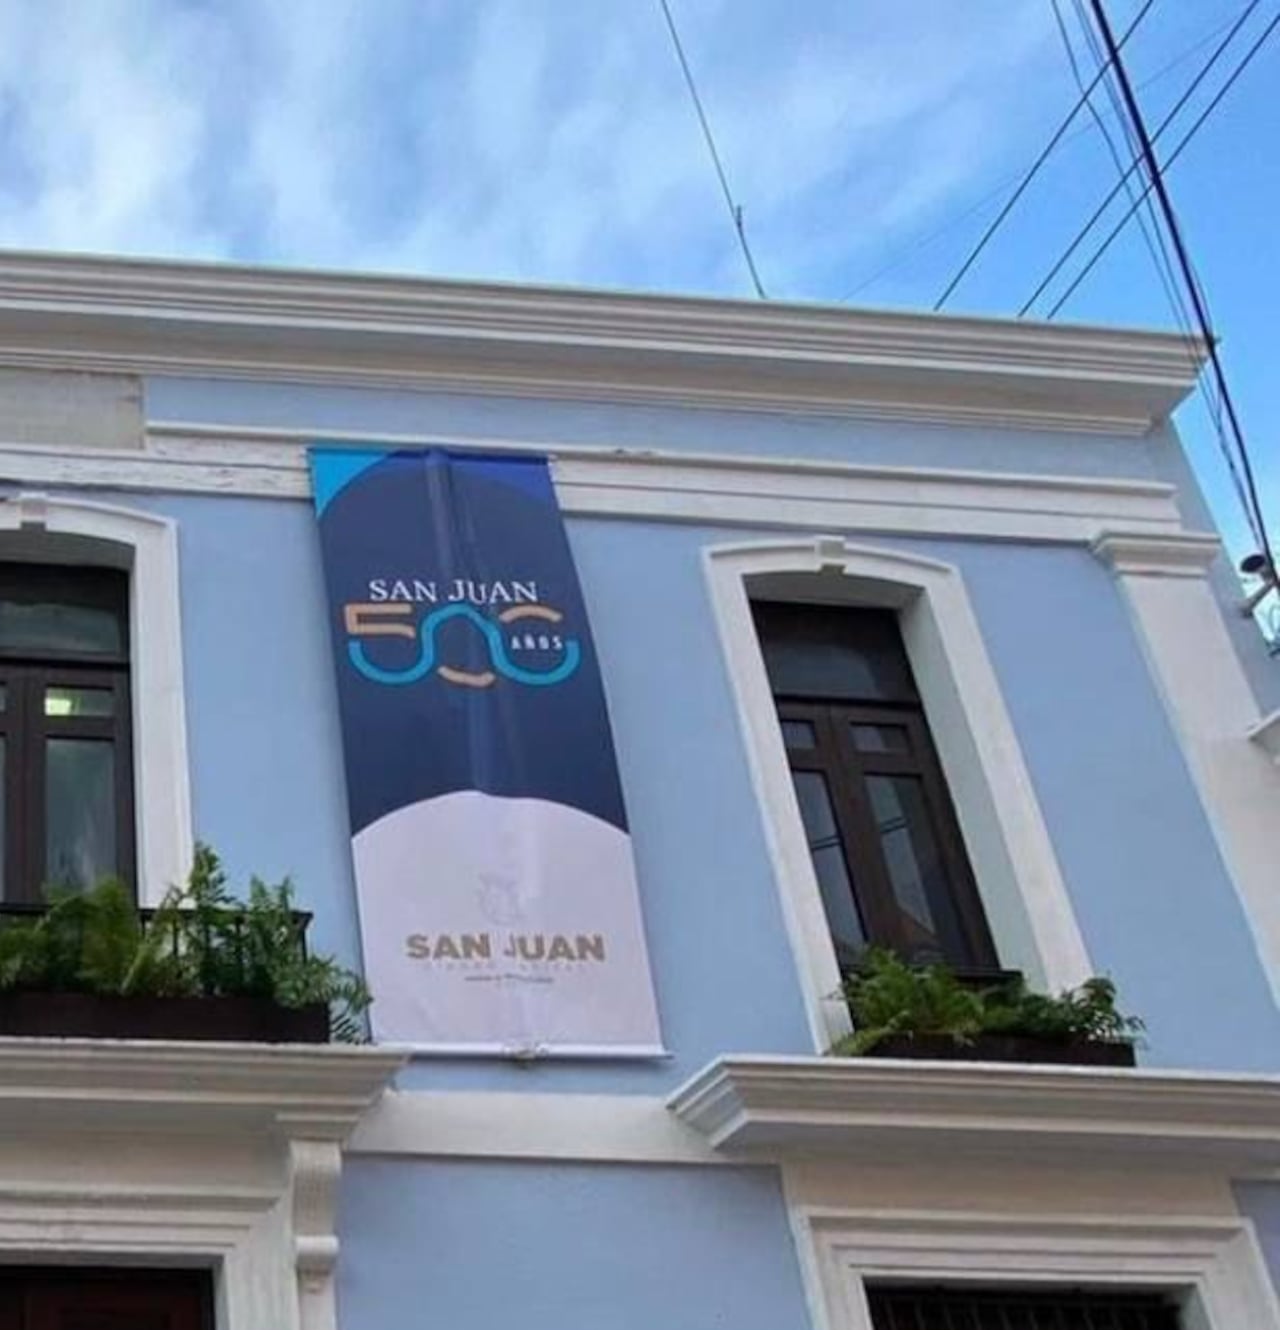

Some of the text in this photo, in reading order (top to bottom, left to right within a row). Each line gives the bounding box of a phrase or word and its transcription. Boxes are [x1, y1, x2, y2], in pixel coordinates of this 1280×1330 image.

[369, 579, 539, 604] SAN JUAN
[406, 933, 606, 962] SAN JUAN
